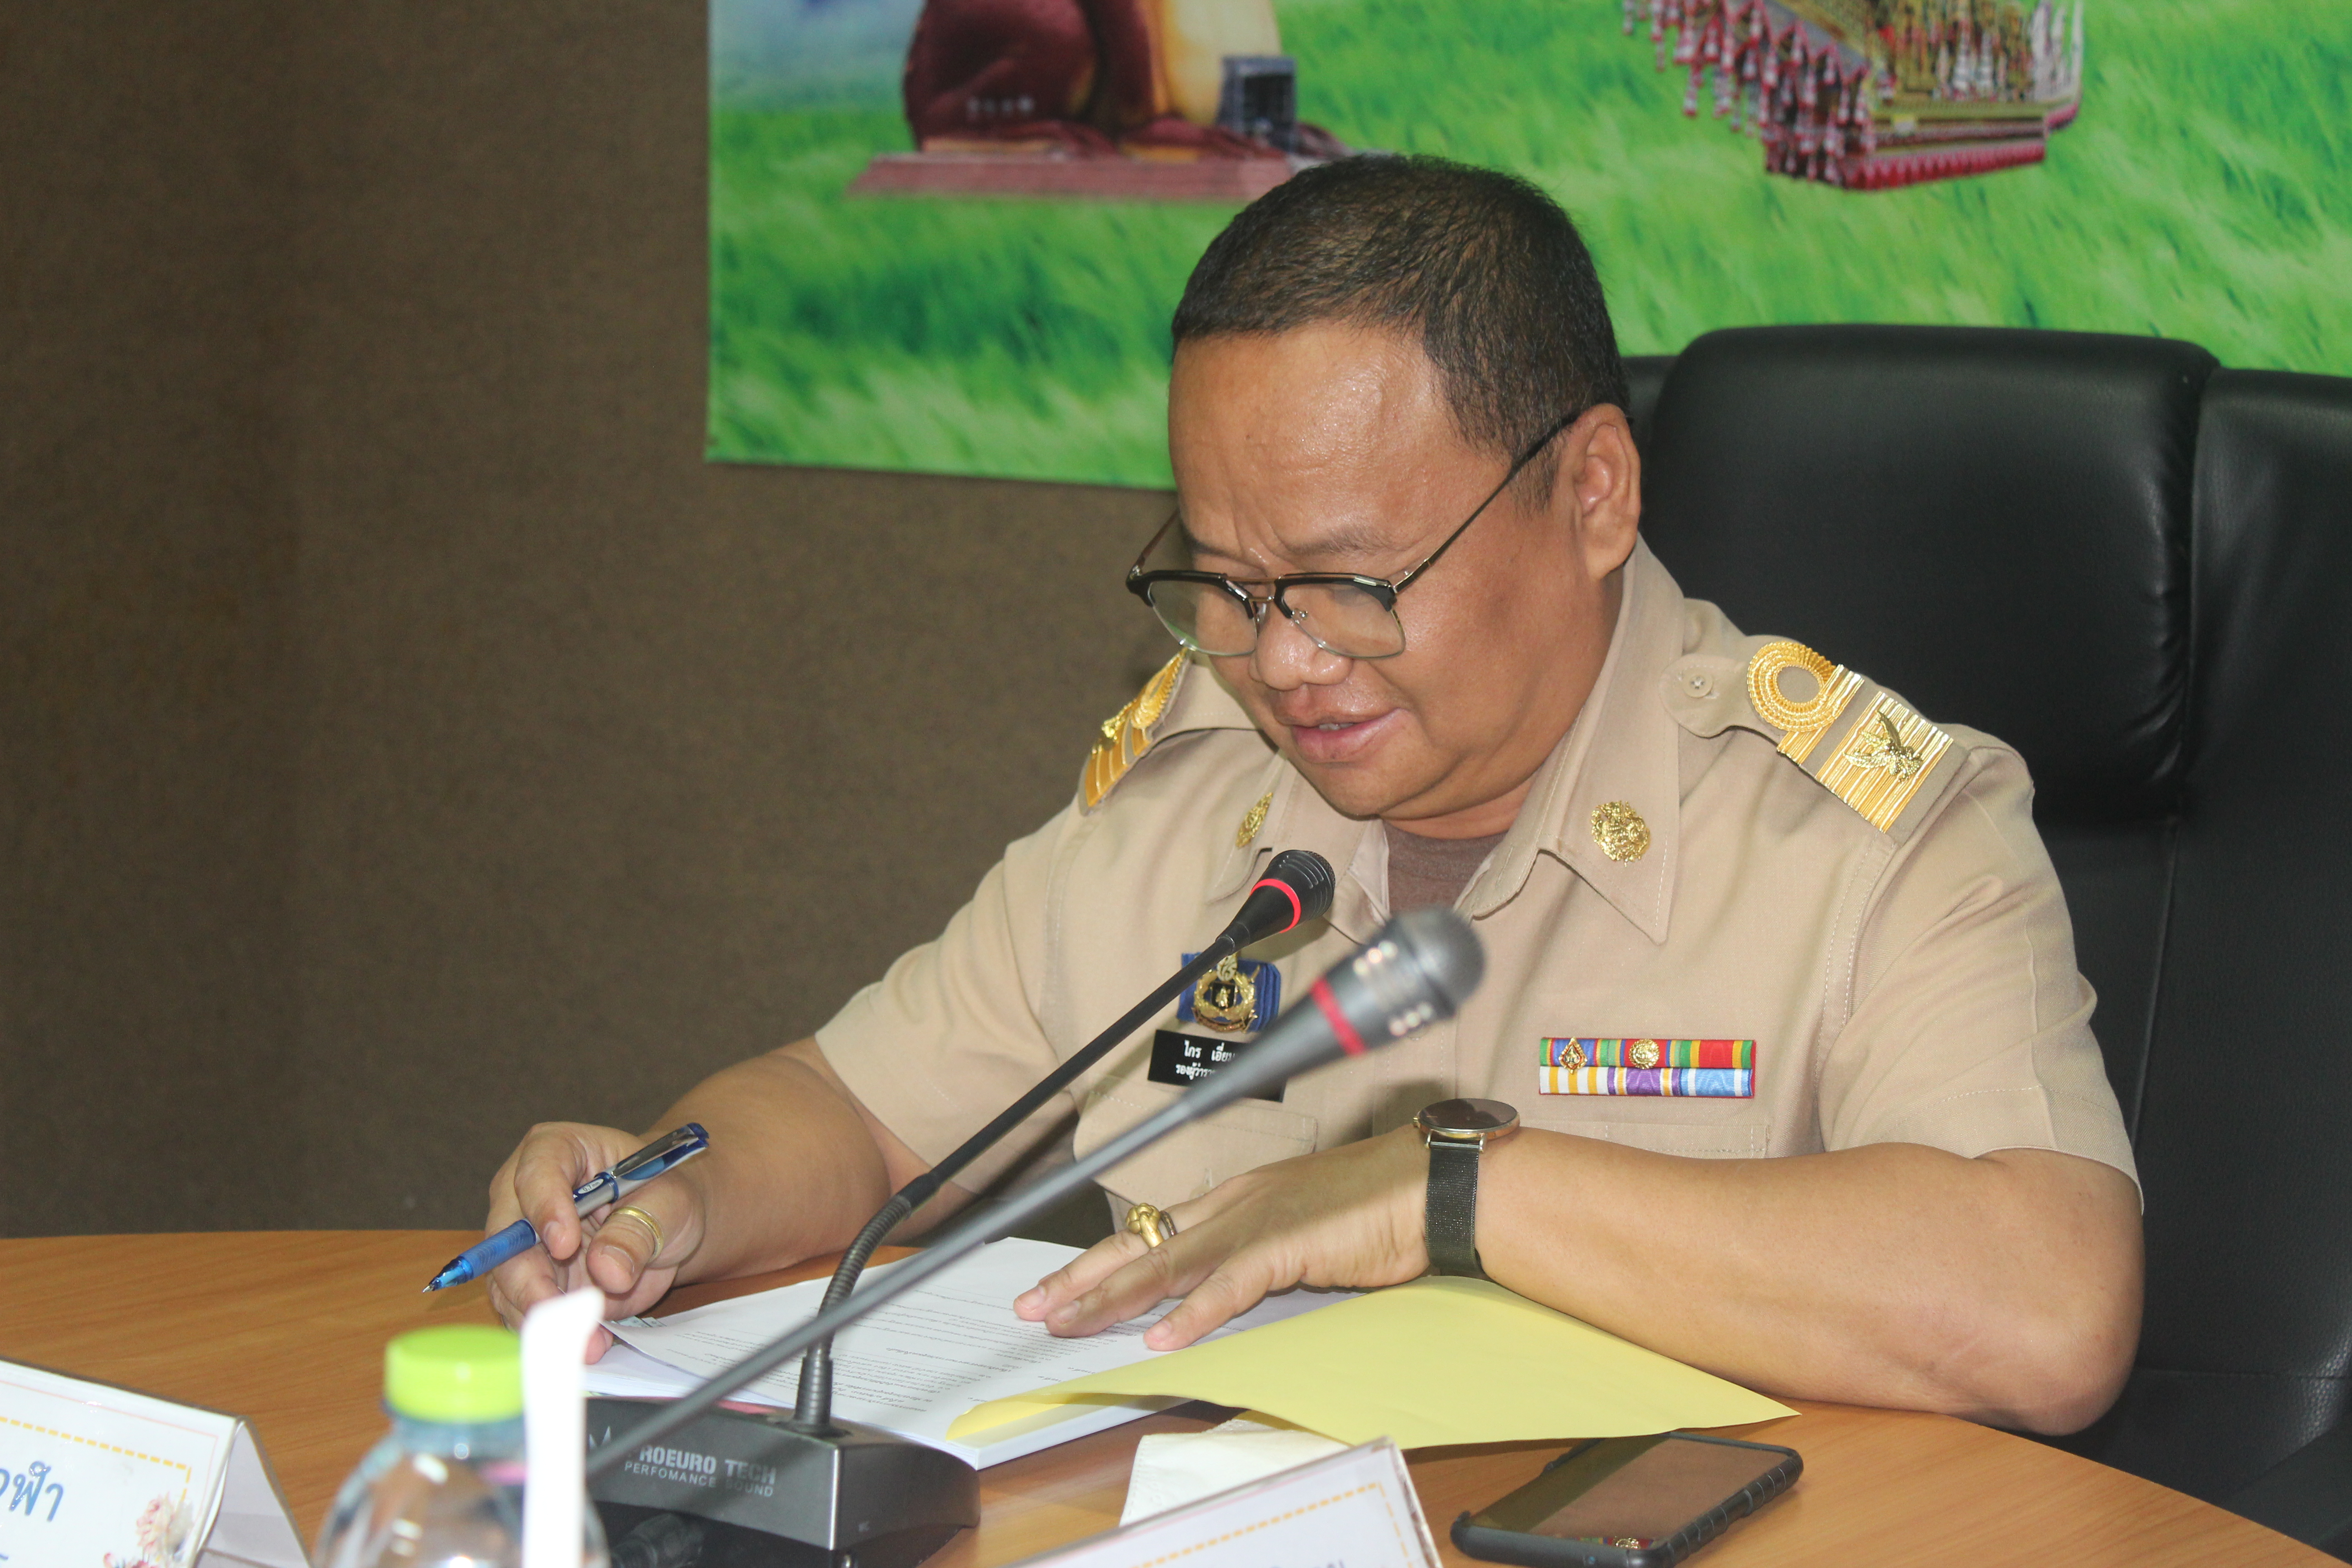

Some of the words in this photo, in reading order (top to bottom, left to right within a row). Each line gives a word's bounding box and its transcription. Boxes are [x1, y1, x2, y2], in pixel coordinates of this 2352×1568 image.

[1184, 1039, 1202, 1058] ไกร
[625, 1461, 717, 1488] PERFOMANCE
[639, 1445, 717, 1475] ROEURO
[725, 1458, 777, 1485] TECH
